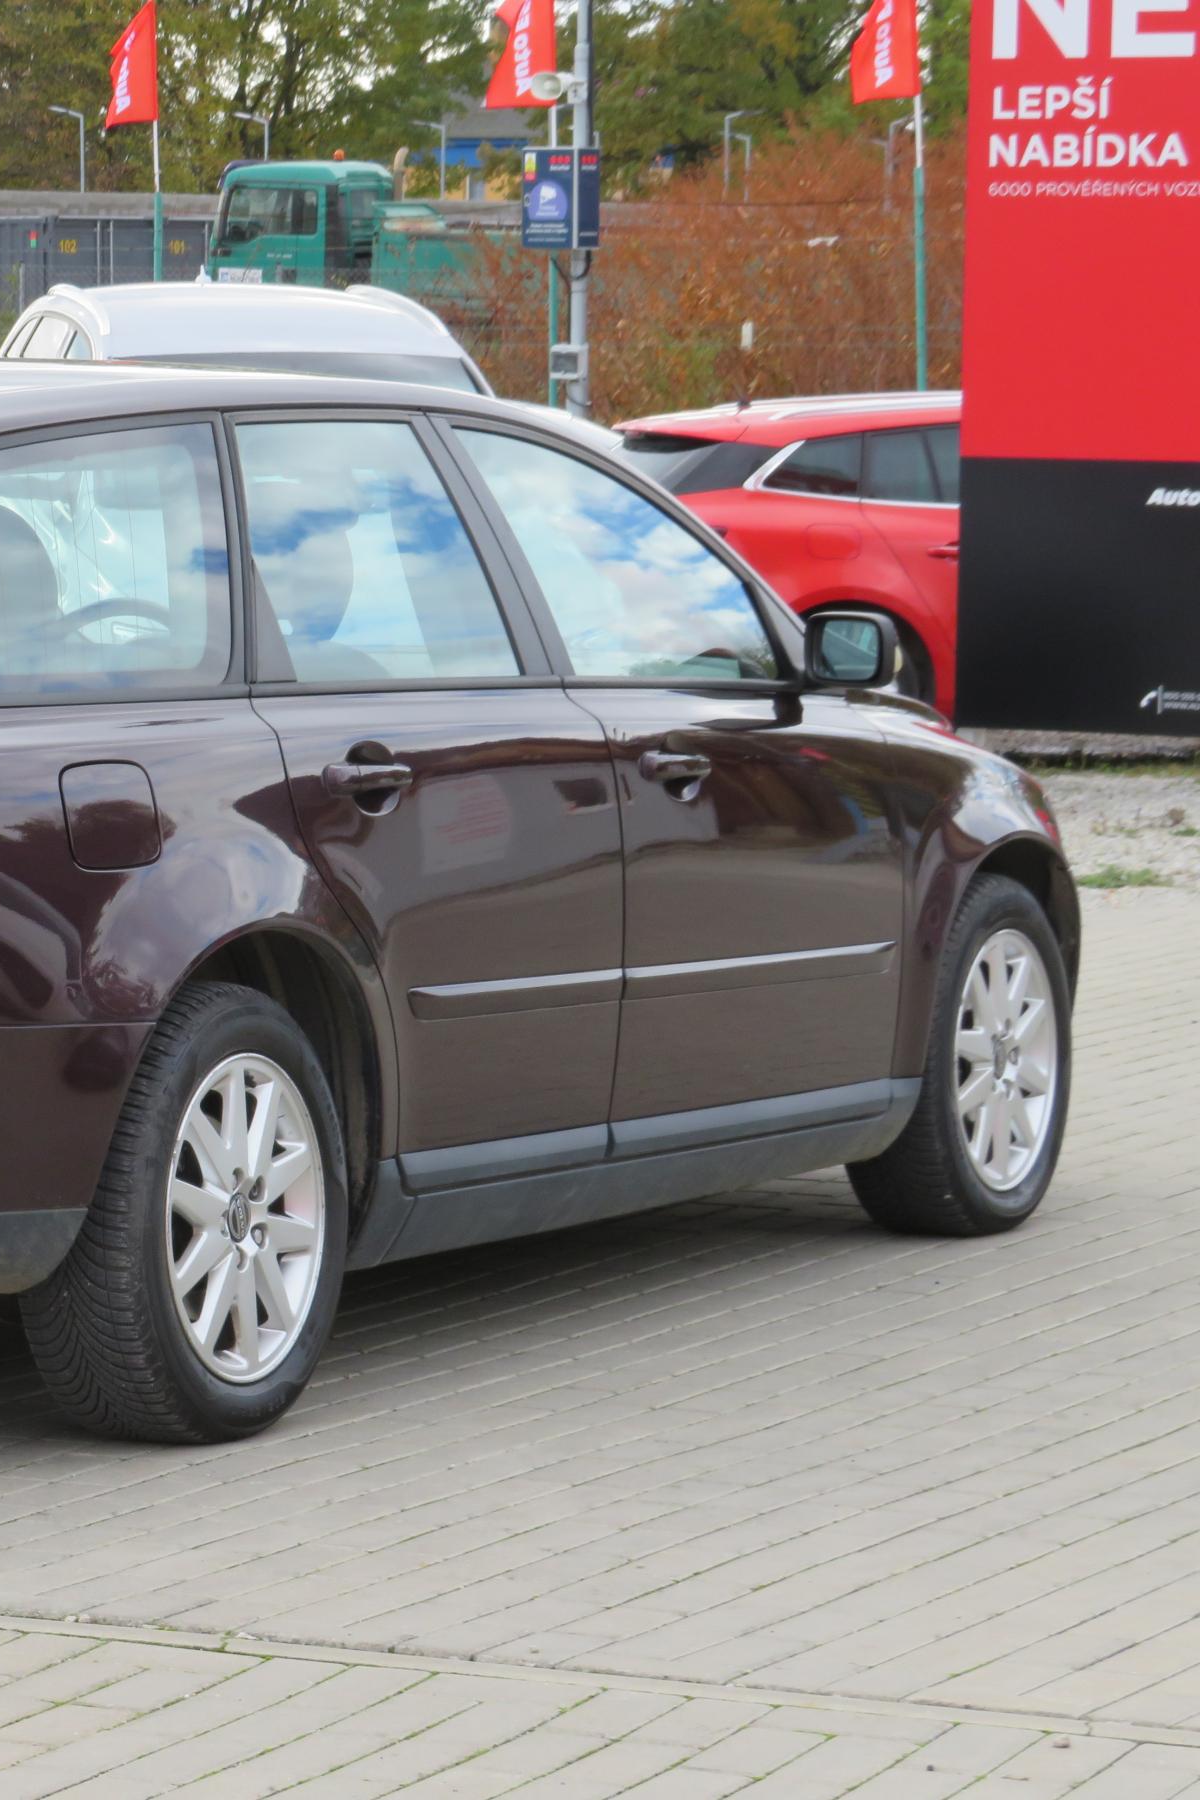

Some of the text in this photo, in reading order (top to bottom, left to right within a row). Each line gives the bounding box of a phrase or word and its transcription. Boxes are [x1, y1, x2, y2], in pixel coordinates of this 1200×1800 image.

[992, 76, 1115, 120] LEPŠÍ
[989, 124, 1190, 168] NABÍDKA
[987, 181, 1032, 197] 6000
[1164, 181, 1200, 197] VOZ
[59, 239, 77, 254] 102
[1146, 487, 1200, 506] Auto
